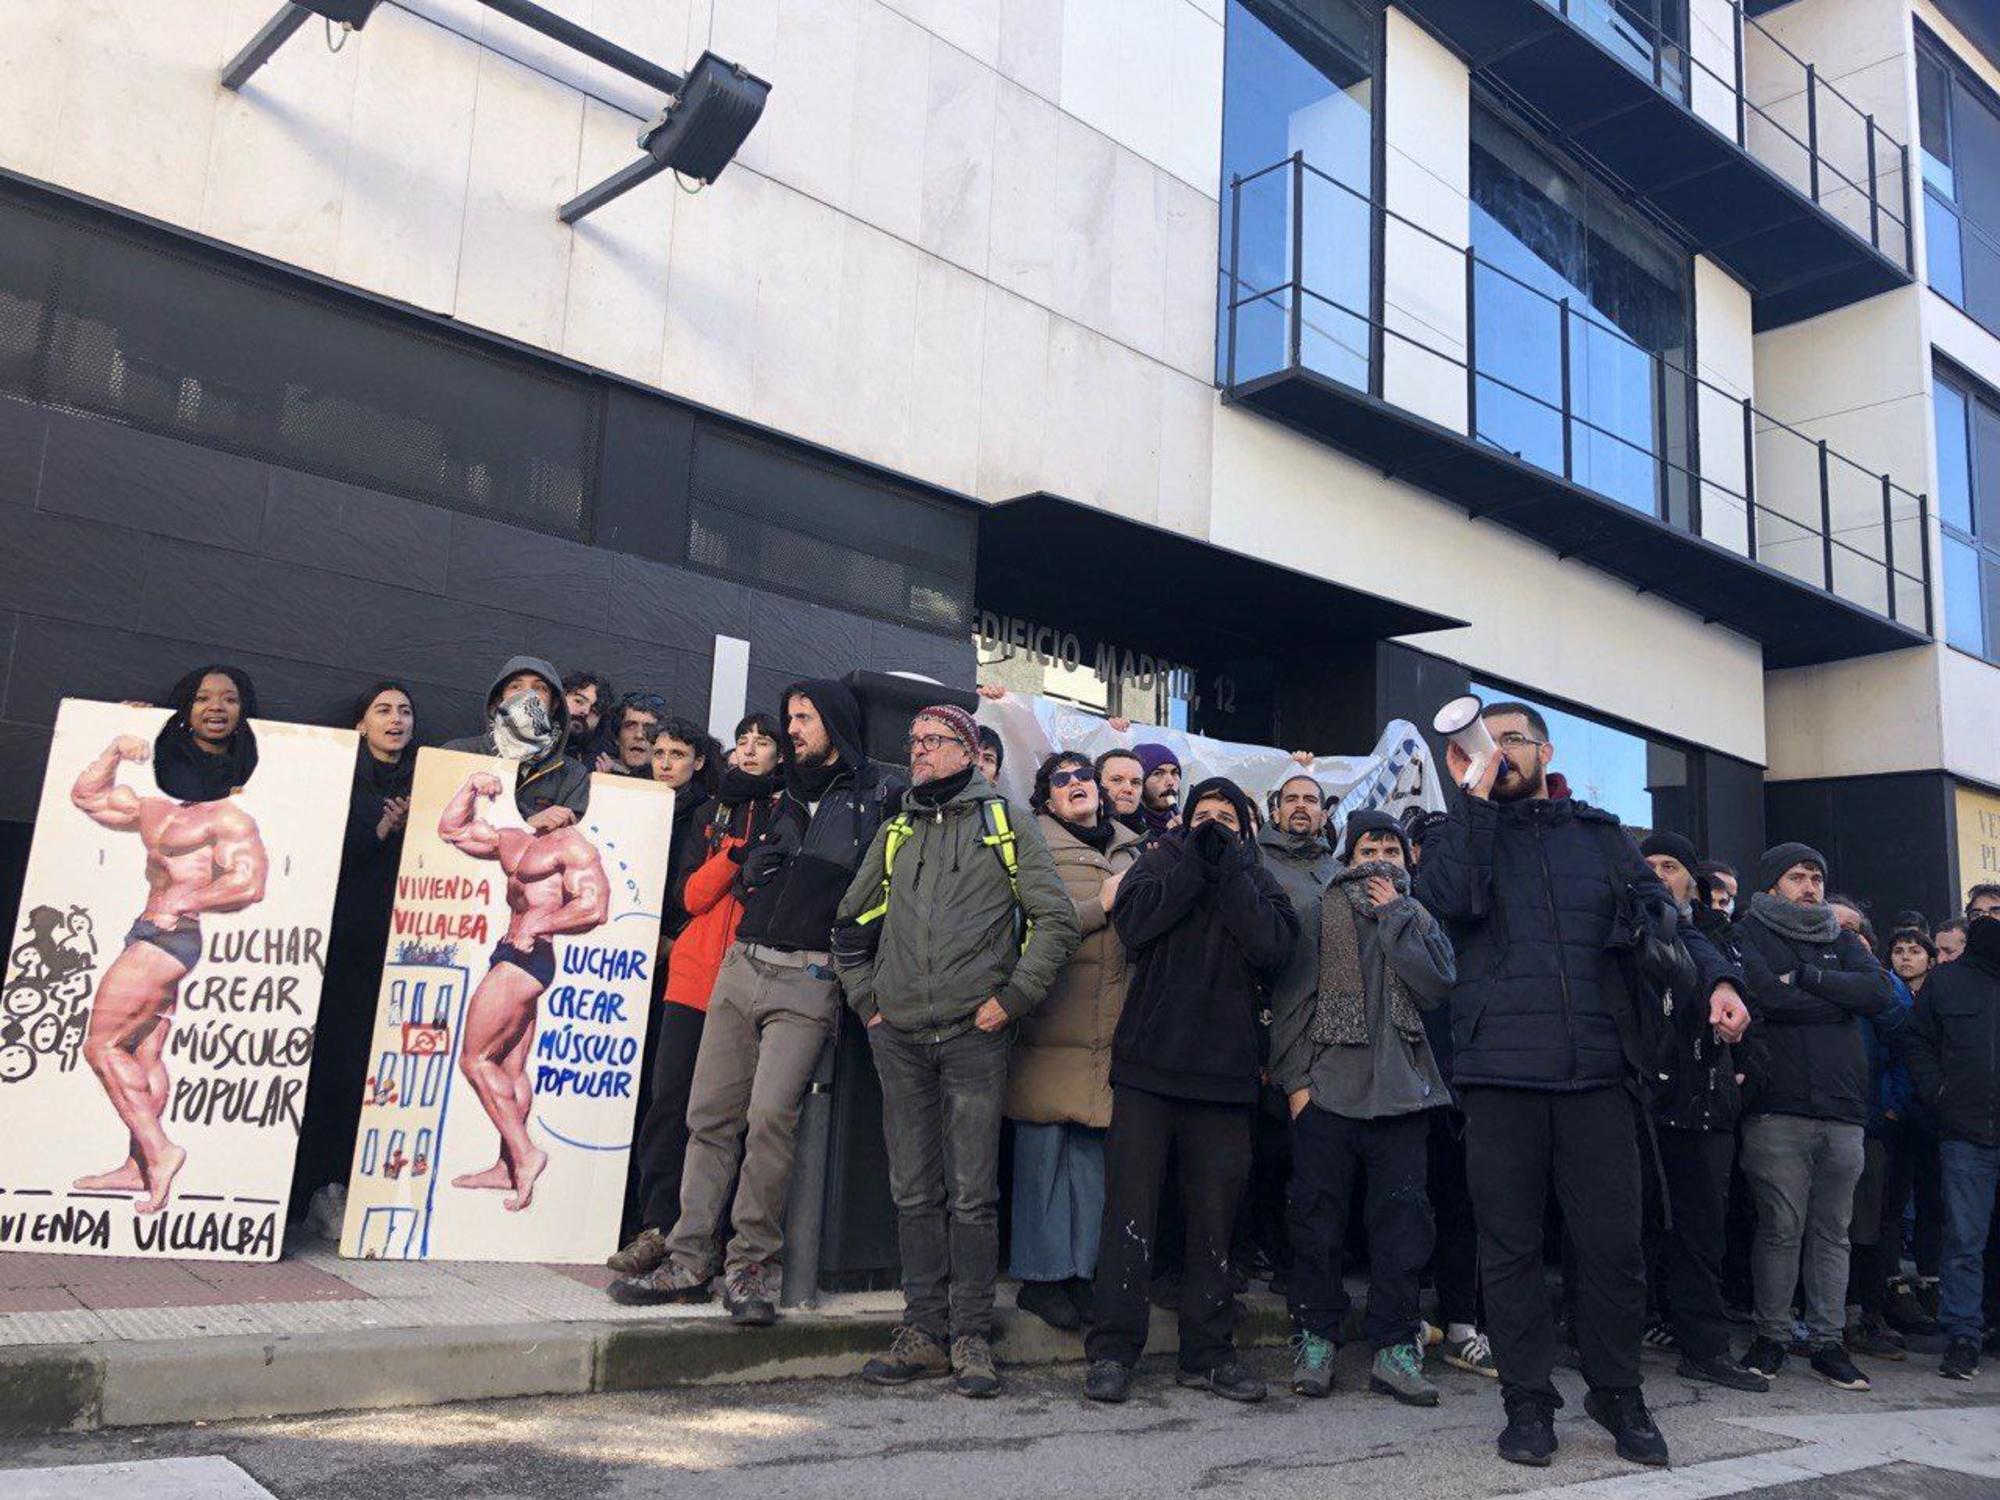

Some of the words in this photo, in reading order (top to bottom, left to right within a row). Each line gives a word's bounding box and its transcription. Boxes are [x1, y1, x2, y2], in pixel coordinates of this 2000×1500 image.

[398, 875, 490, 904] VIVIENDA
[393, 911, 488, 944] VILLALBA
[209, 927, 326, 974] LUCHAR
[564, 945, 647, 981] LUCHAR
[184, 975, 302, 1015] CREAR
[548, 985, 628, 1023] CREAR
[537, 1024, 638, 1065] MÚSCULO
[534, 1064, 631, 1098] POPULAR
[171, 1076, 303, 1136] POPULAR
[134, 1211, 275, 1257] VILLALBA
